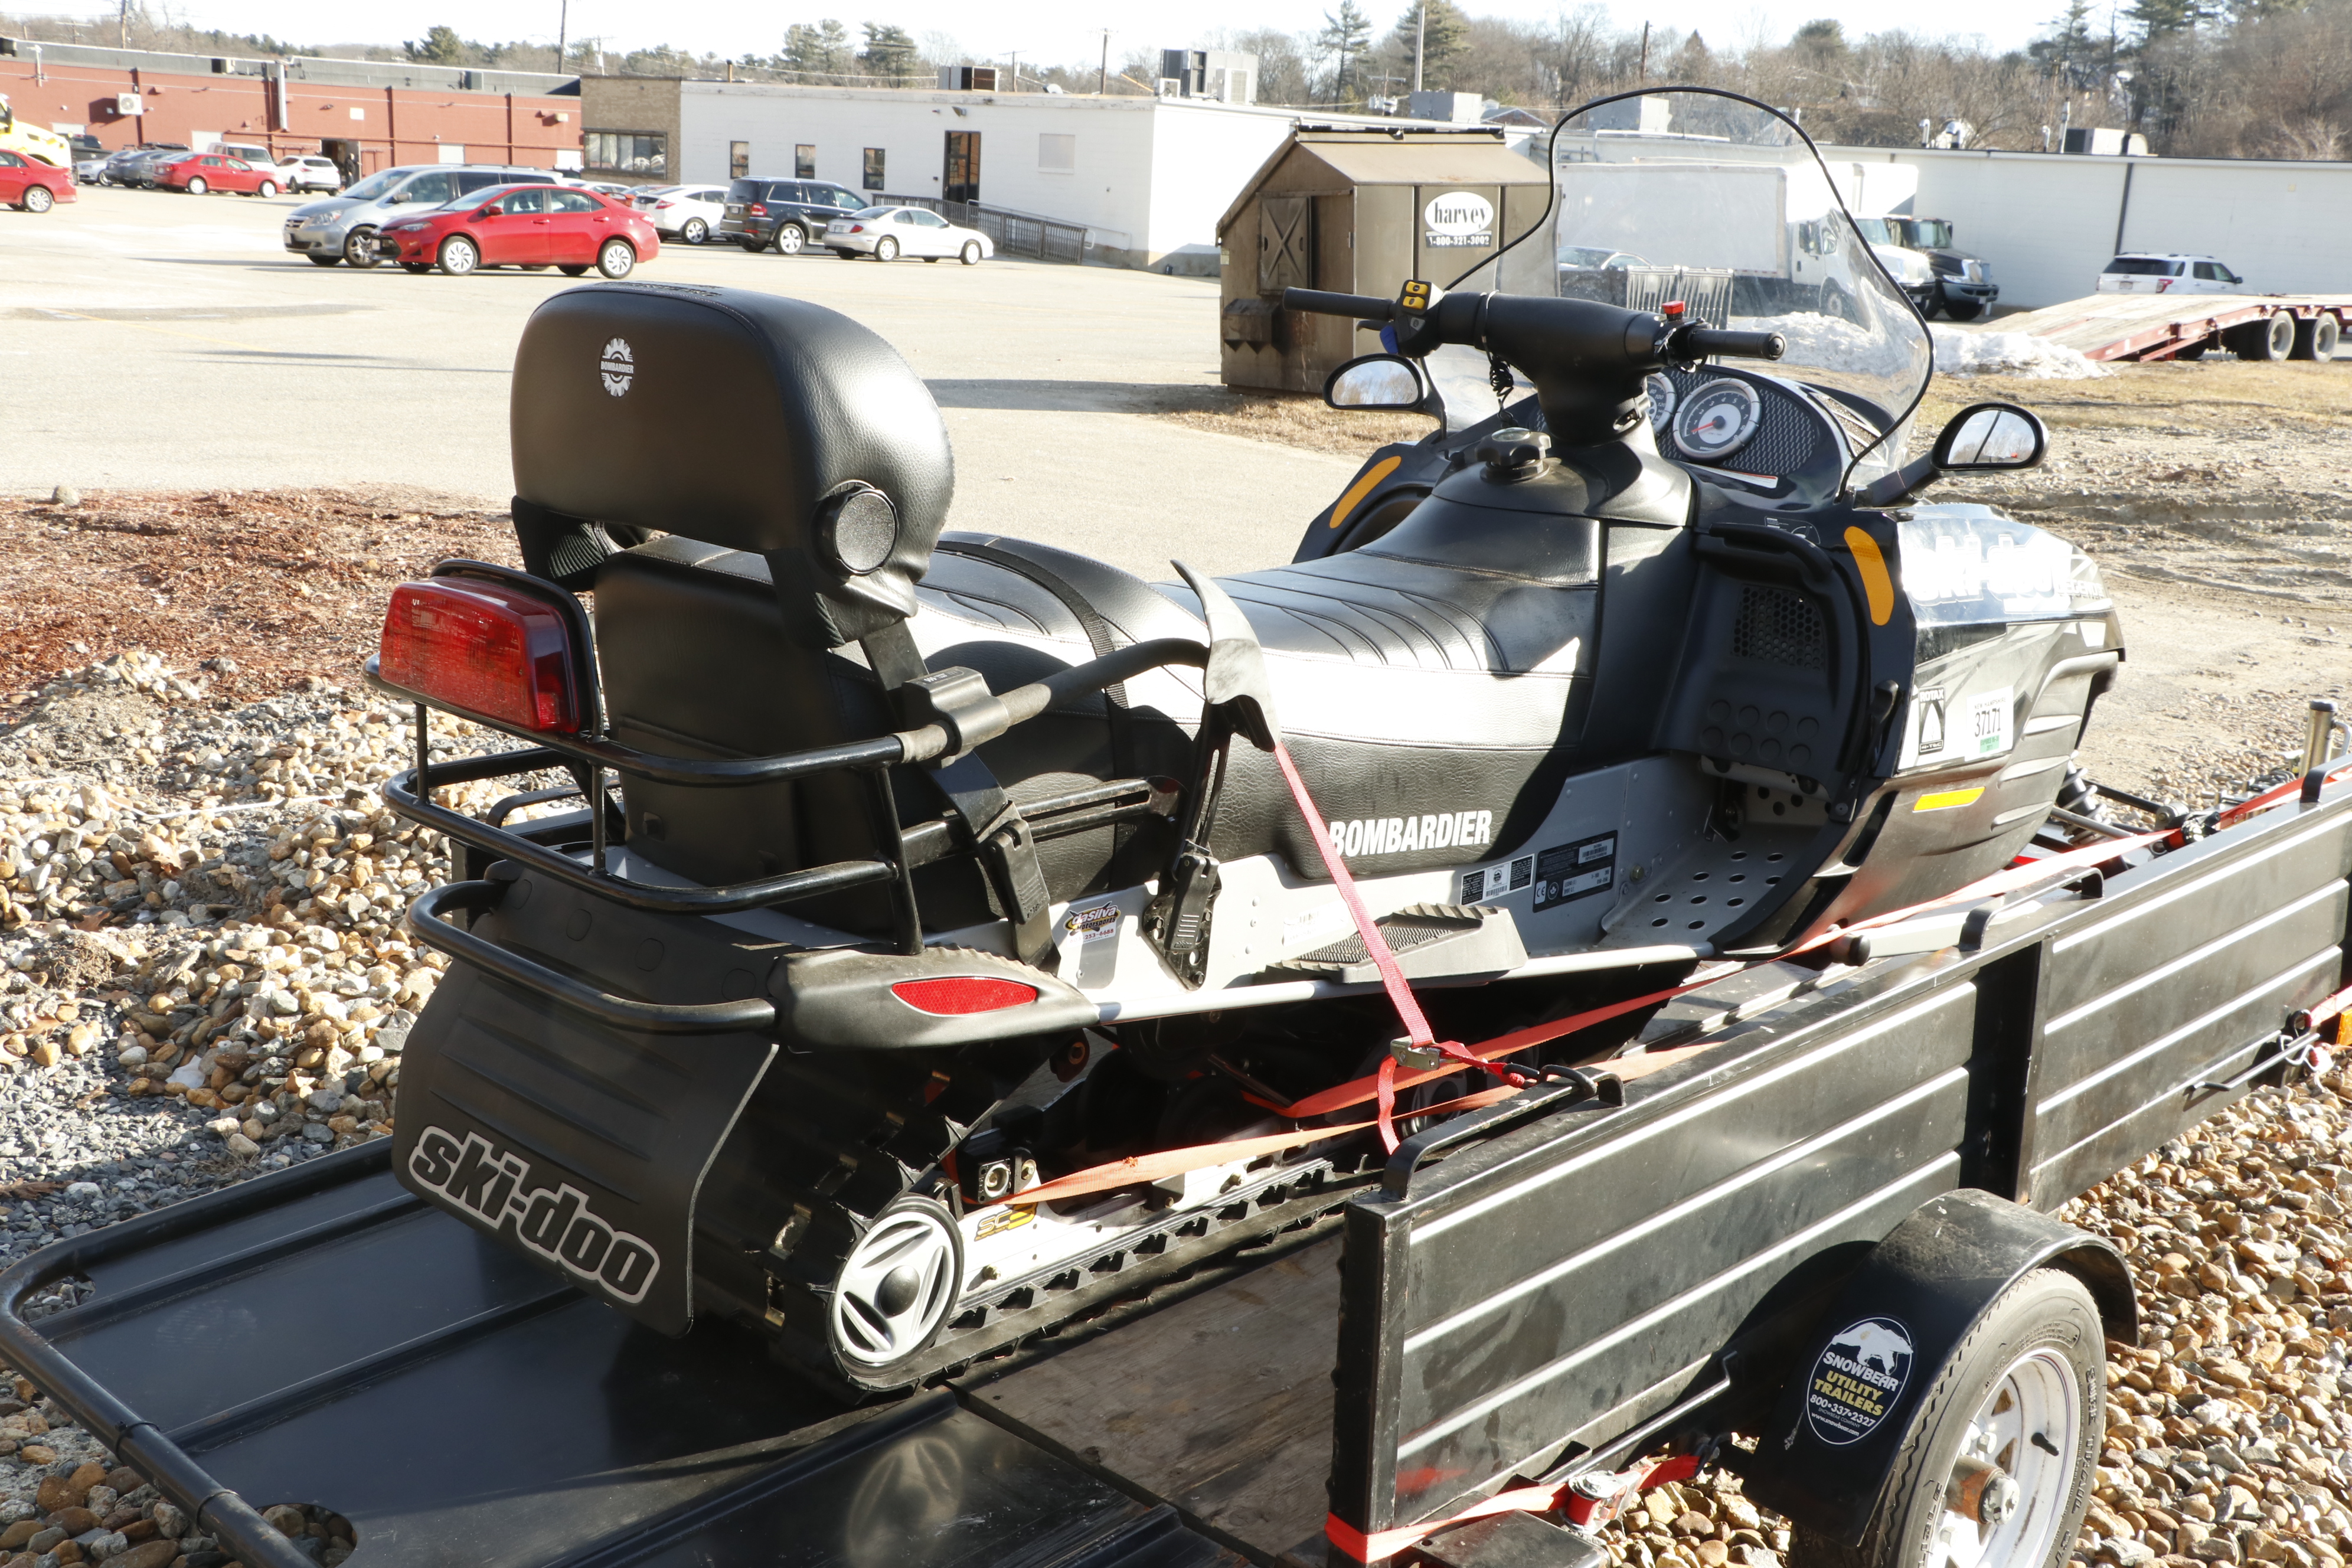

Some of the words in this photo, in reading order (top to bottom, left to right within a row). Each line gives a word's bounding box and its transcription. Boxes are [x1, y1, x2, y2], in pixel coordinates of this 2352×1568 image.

[1434, 201, 1488, 229] harvey
[1429, 236, 1489, 246] 1-800-321-3002
[600, 361, 634, 374] BOMBARDIER
[1920, 689, 1944, 703] ROTAX
[1984, 697, 2006, 707] HAMPSHIRE
[1974, 707, 2001, 737] 37171
[1328, 809, 1491, 857] BOMBARDIER
[1537, 886, 1546, 897] CE
[1076, 917, 1116, 930] Motorsports
[410, 1126, 659, 1304] ski-doo
[1823, 1351, 1899, 1392] SNOWBEAR
[1814, 1378, 1884, 1416] TRAILERS
[1826, 1370, 1884, 1401] UTILITY
[1811, 1412, 1860, 1436] www.snowbear.com
[1818, 1407, 1840, 1421] SNOWBEAR
[1840, 1417, 1860, 1429] COMPANY
